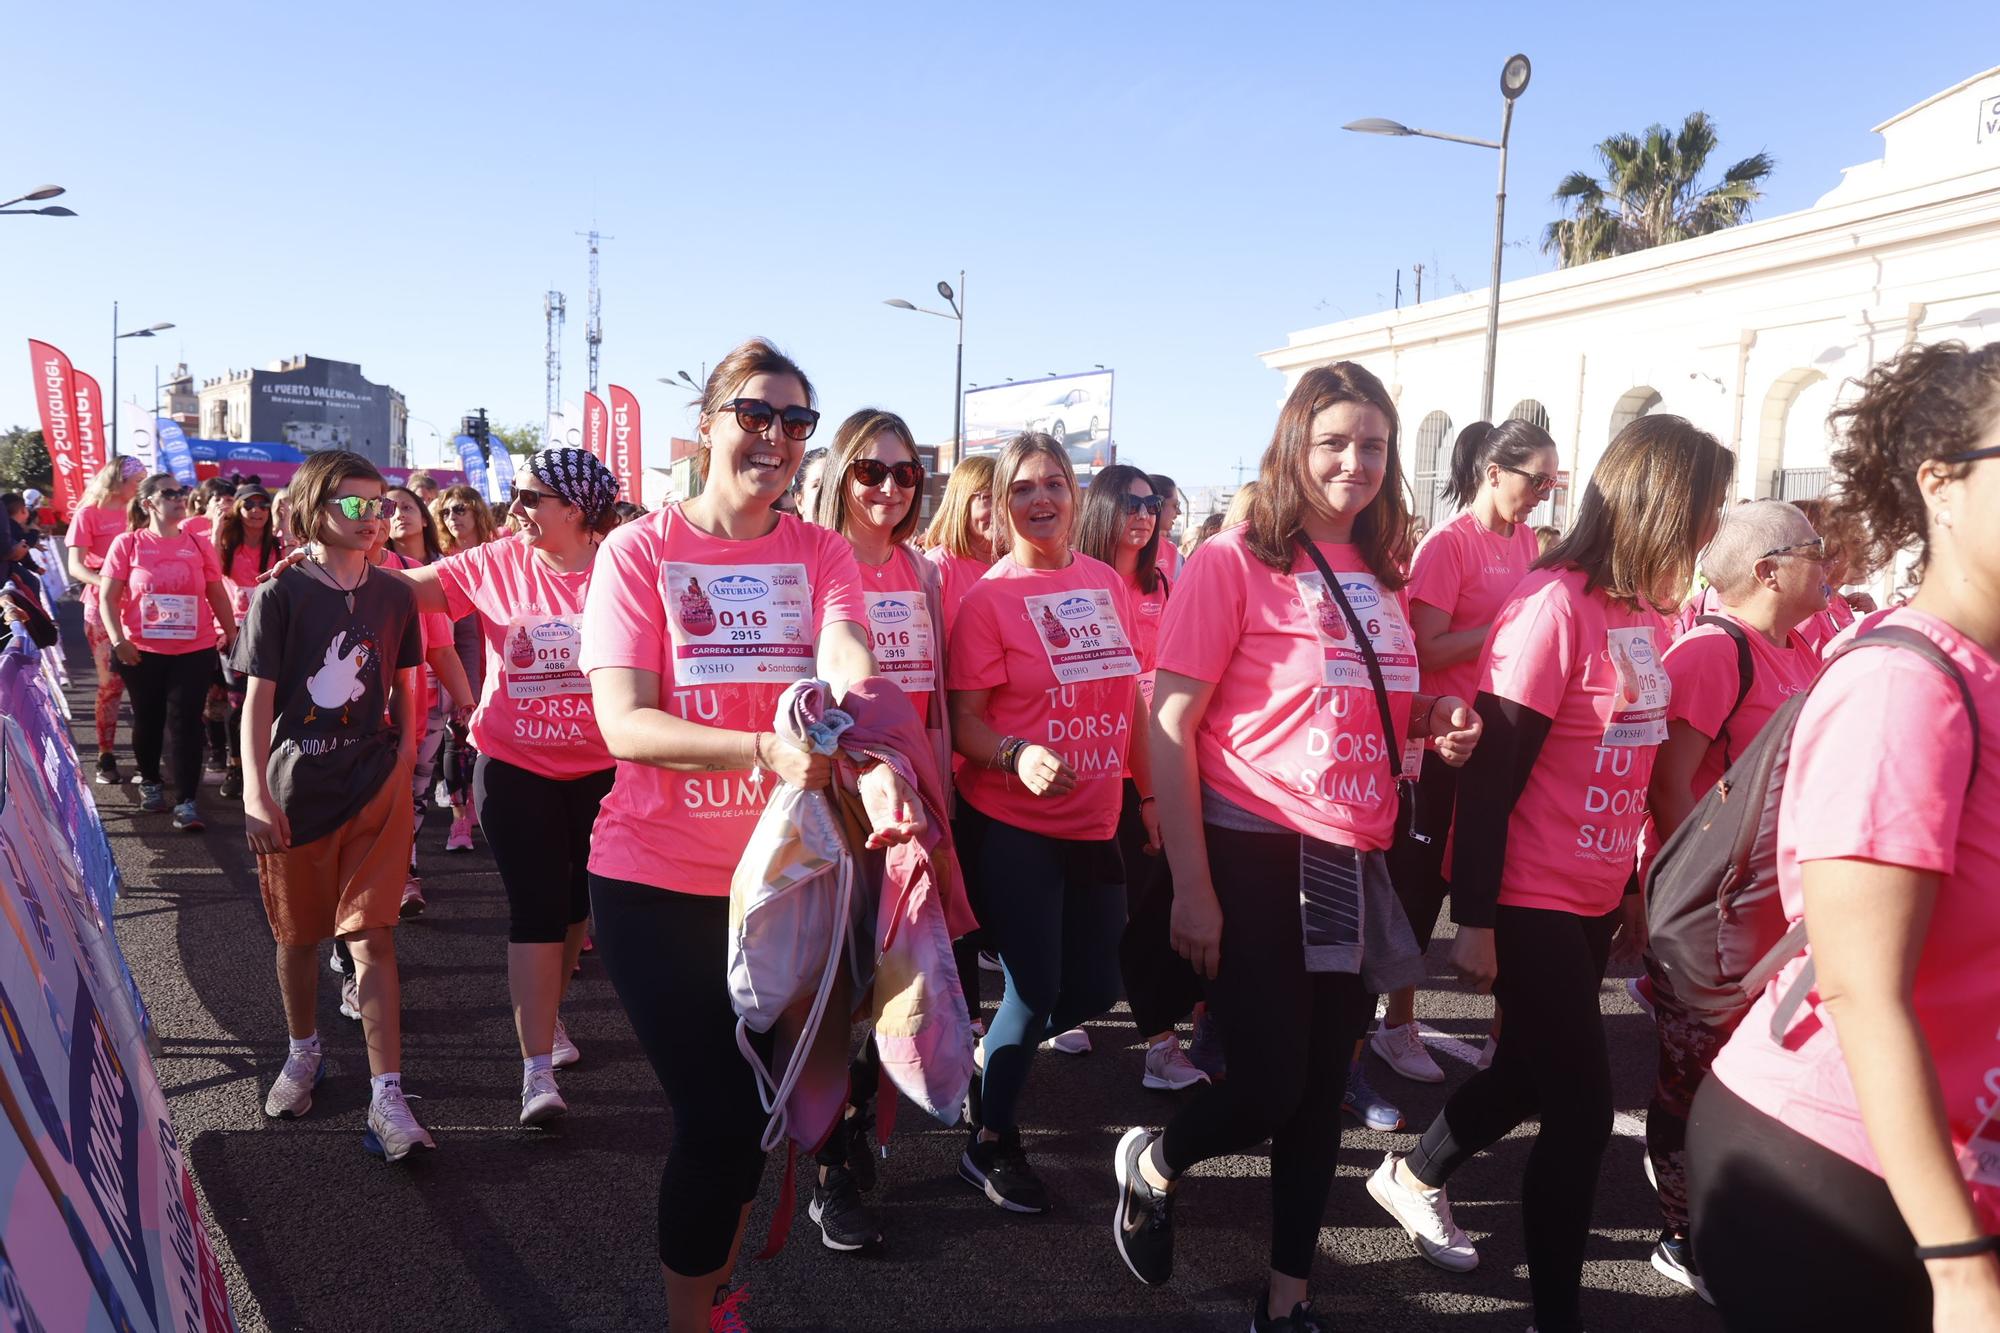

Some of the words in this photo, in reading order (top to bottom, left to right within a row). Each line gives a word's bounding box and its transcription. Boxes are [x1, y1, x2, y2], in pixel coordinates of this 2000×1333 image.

[274, 384, 311, 396] PUERTO
[713, 584, 765, 595] ASTURIANA
[719, 610, 767, 627] 016
[873, 610, 909, 618] ASTURIANA
[731, 630, 761, 641] 2915
[1069, 623, 1101, 638] 016
[876, 631, 910, 646] 016
[1081, 640, 1100, 648] 2916
[538, 648, 571, 660] 016
[692, 647, 731, 655] CARRERA
[885, 649, 905, 658] 2919
[544, 662, 565, 670] 4086
[689, 664, 735, 676] OYSHO
[768, 663, 807, 673] Santander
[1062, 667, 1089, 676] OYSHO
[1382, 673, 1412, 681] antander
[1639, 673, 1656, 691] 016
[673, 689, 718, 720] TU
[1045, 685, 1075, 709] TU
[1312, 687, 1349, 718] TU
[514, 719, 583, 739] SUMA
[1048, 711, 1128, 743] DORSA
[1614, 729, 1646, 738] OYSHO
[1305, 727, 1389, 762] DORSA
[1064, 746, 1121, 772] UMA
[1594, 746, 1632, 776] TU
[1297, 768, 1382, 802] SUMA
[684, 778, 766, 809] SUM
[1585, 785, 1648, 816] DORS
[87, 1019, 138, 1275] Noraut
